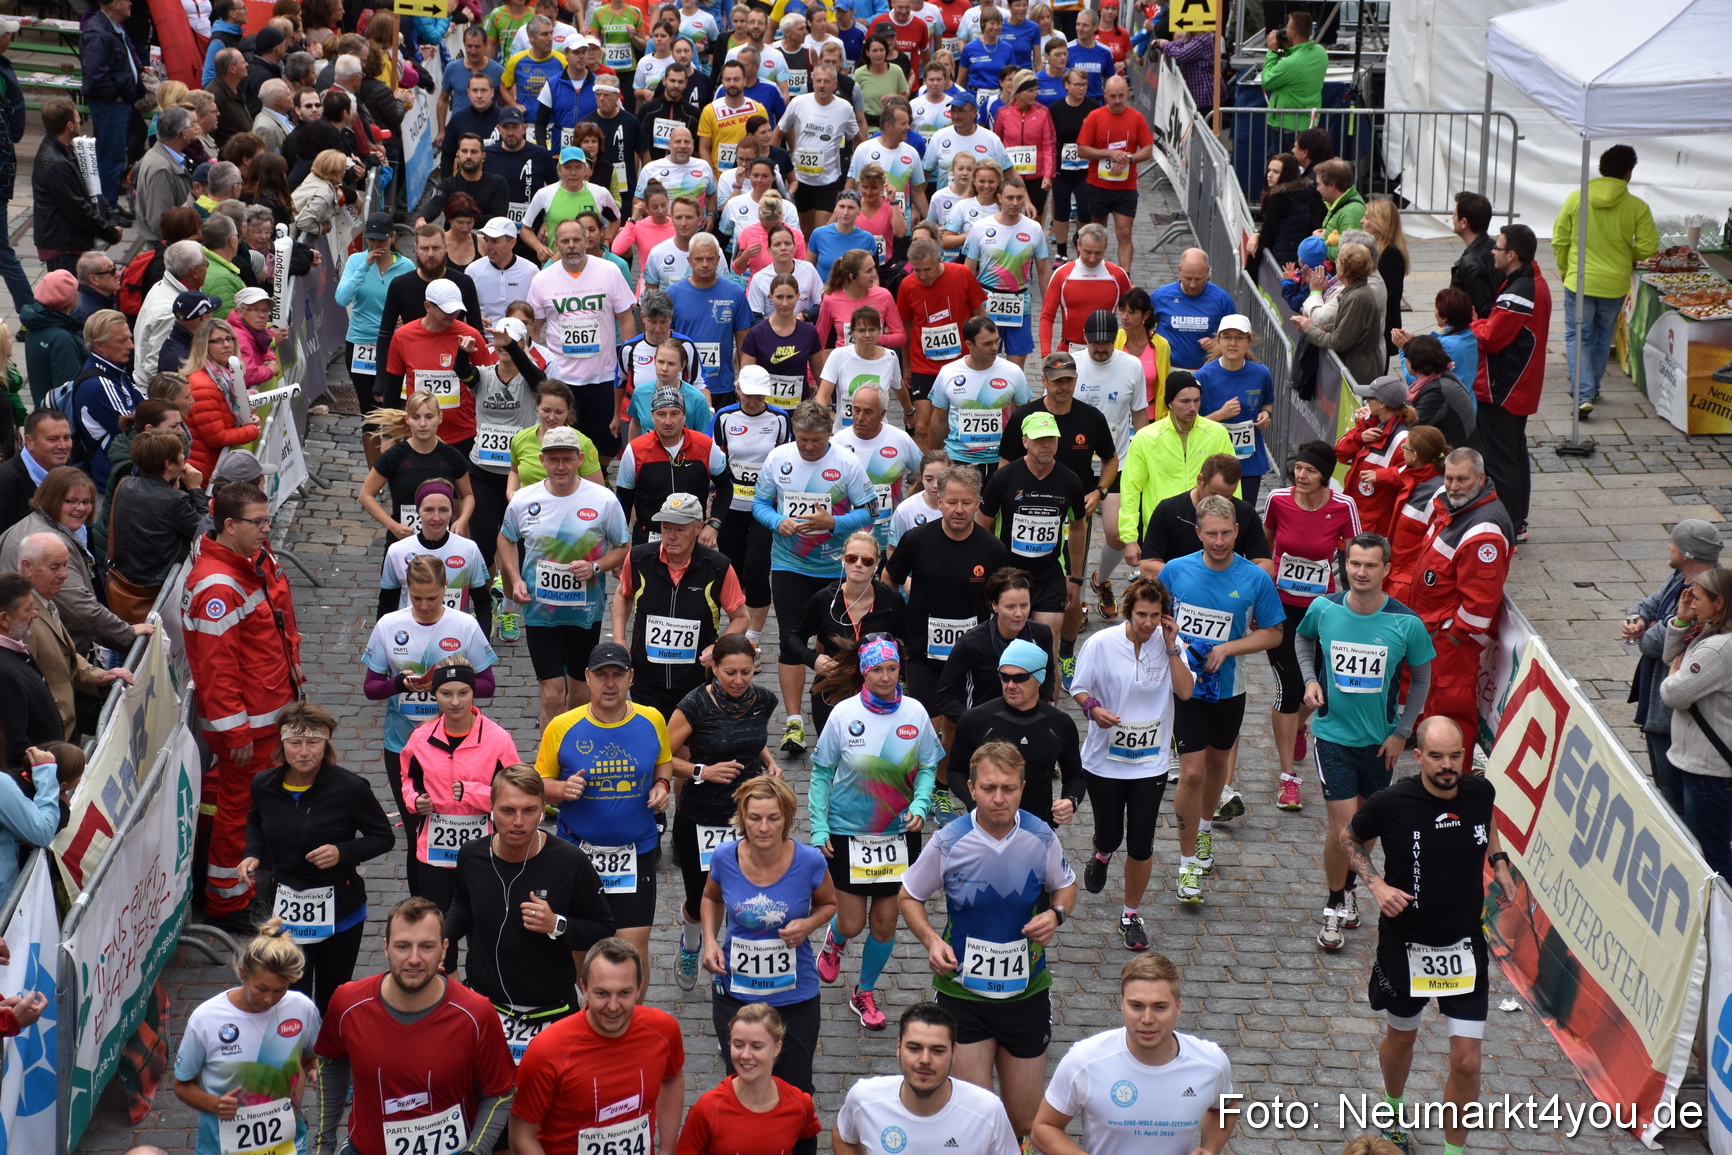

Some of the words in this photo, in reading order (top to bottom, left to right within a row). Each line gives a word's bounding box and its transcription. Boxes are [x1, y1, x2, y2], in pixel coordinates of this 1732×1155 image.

[608, 49, 630, 60] 2753
[718, 120, 732, 128] MAX
[804, 122, 825, 133] Allianz
[800, 154, 818, 166] 232
[1012, 152, 1031, 164] 178
[1065, 150, 1078, 161] 23
[274, 250, 284, 294] Laufsport
[272, 296, 282, 320] BMW
[552, 294, 606, 314] VOGT
[990, 301, 1020, 314] 2455
[1171, 316, 1209, 325] HUBER
[564, 330, 596, 344] 2667
[925, 332, 958, 348] 2440
[358, 346, 373, 360] 21
[776, 346, 796, 356] RUN
[424, 380, 452, 394] 529
[772, 382, 796, 397] 174
[248, 396, 268, 408] Laufs
[482, 400, 520, 410] adidas
[964, 418, 998, 433] 2756
[1016, 524, 1055, 542] 2185
[1284, 563, 1325, 583] 2071
[541, 572, 582, 590] 3068
[1291, 583, 1312, 592] Agnes
[1181, 606, 1197, 616] PARTL
[1198, 611, 1224, 620] Neumarkt
[1180, 616, 1226, 638] 2577
[650, 627, 694, 647] 2478
[658, 650, 682, 658] Hubert
[1351, 647, 1378, 655] Neumarkt
[1335, 654, 1381, 675] 2414
[1350, 678, 1361, 686] Kai
[414, 706, 436, 714] Sabin
[1114, 729, 1158, 748] 2647
[1125, 750, 1144, 758] Silvia
[430, 818, 450, 826] PARTL
[1435, 820, 1461, 830] skinfit
[444, 852, 458, 860] Ker
[862, 844, 897, 864] 310
[865, 868, 894, 876] Claudia
[278, 888, 293, 898] PARTL
[280, 899, 327, 922] 2381
[1525, 830, 1664, 1042] PFLASTERSTEINE
[733, 942, 752, 952] PARTL
[754, 944, 785, 952] Neumarkt
[967, 942, 988, 953] PARTL
[990, 946, 1020, 954] Neumarkt
[1432, 944, 1462, 953] Neumarkt
[737, 952, 790, 974] 2113
[970, 954, 1024, 977] 2114
[1422, 954, 1462, 976] 330
[752, 980, 775, 988] Petra
[988, 982, 1004, 991] Sigi
[1428, 980, 1460, 990] Markus
[280, 1023, 301, 1032] Hervis
[397, 1098, 416, 1108] DEHN
[610, 1103, 629, 1114] DEHN
[246, 1108, 281, 1120] Neumarkt
[386, 1126, 412, 1136] PARTL
[414, 1116, 450, 1132] Neumarkt
[236, 1118, 282, 1150] 202
[607, 1126, 640, 1139] Neumarkt
[395, 1124, 460, 1155] 2473
